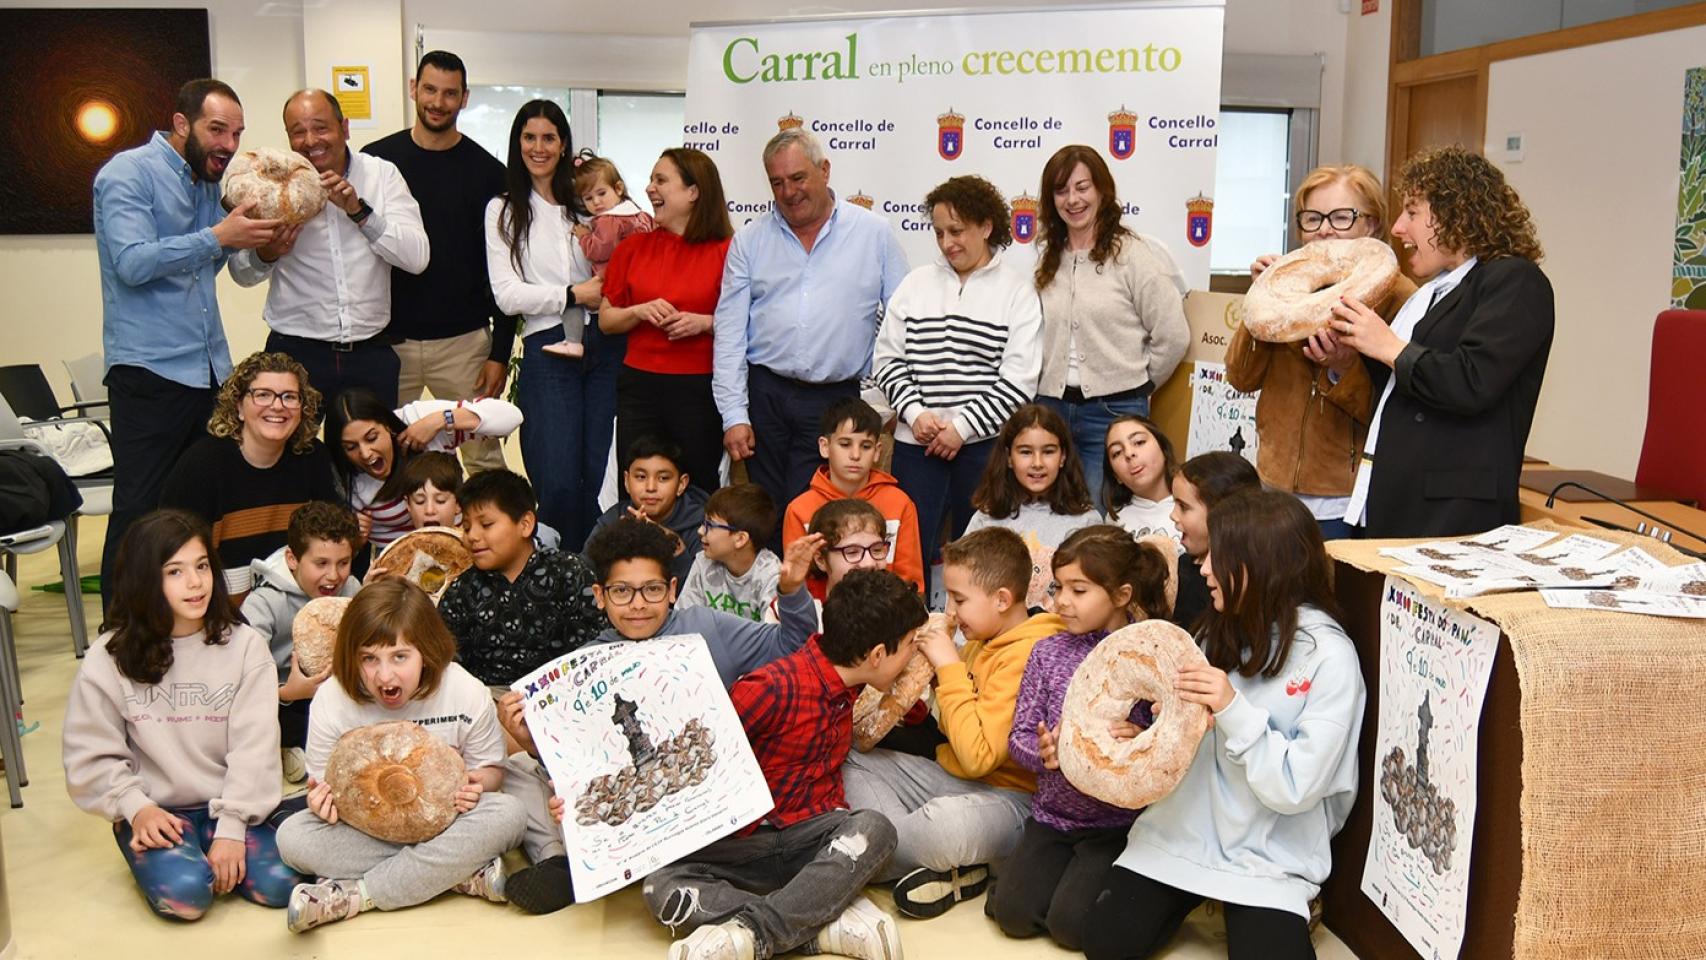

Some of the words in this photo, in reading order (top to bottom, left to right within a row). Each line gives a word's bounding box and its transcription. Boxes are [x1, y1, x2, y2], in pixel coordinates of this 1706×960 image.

[722, 32, 860, 84] Carral
[868, 62, 892, 77] en
[899, 54, 954, 83] pleno
[962, 42, 1182, 75] crecemento
[683, 122, 717, 134] cello
[722, 122, 739, 134] de
[812, 119, 873, 132] Concello
[878, 119, 895, 132] de
[974, 117, 1038, 130] Concello
[1043, 117, 1062, 130] de
[1148, 115, 1216, 129] Concello
[683, 139, 720, 151] arral
[829, 137, 876, 150] Carral
[993, 136, 1041, 149] Carral
[1168, 134, 1218, 148] Carral
[727, 201, 775, 213] Concell
[883, 201, 925, 213] Conce
[901, 219, 933, 231] Carr
